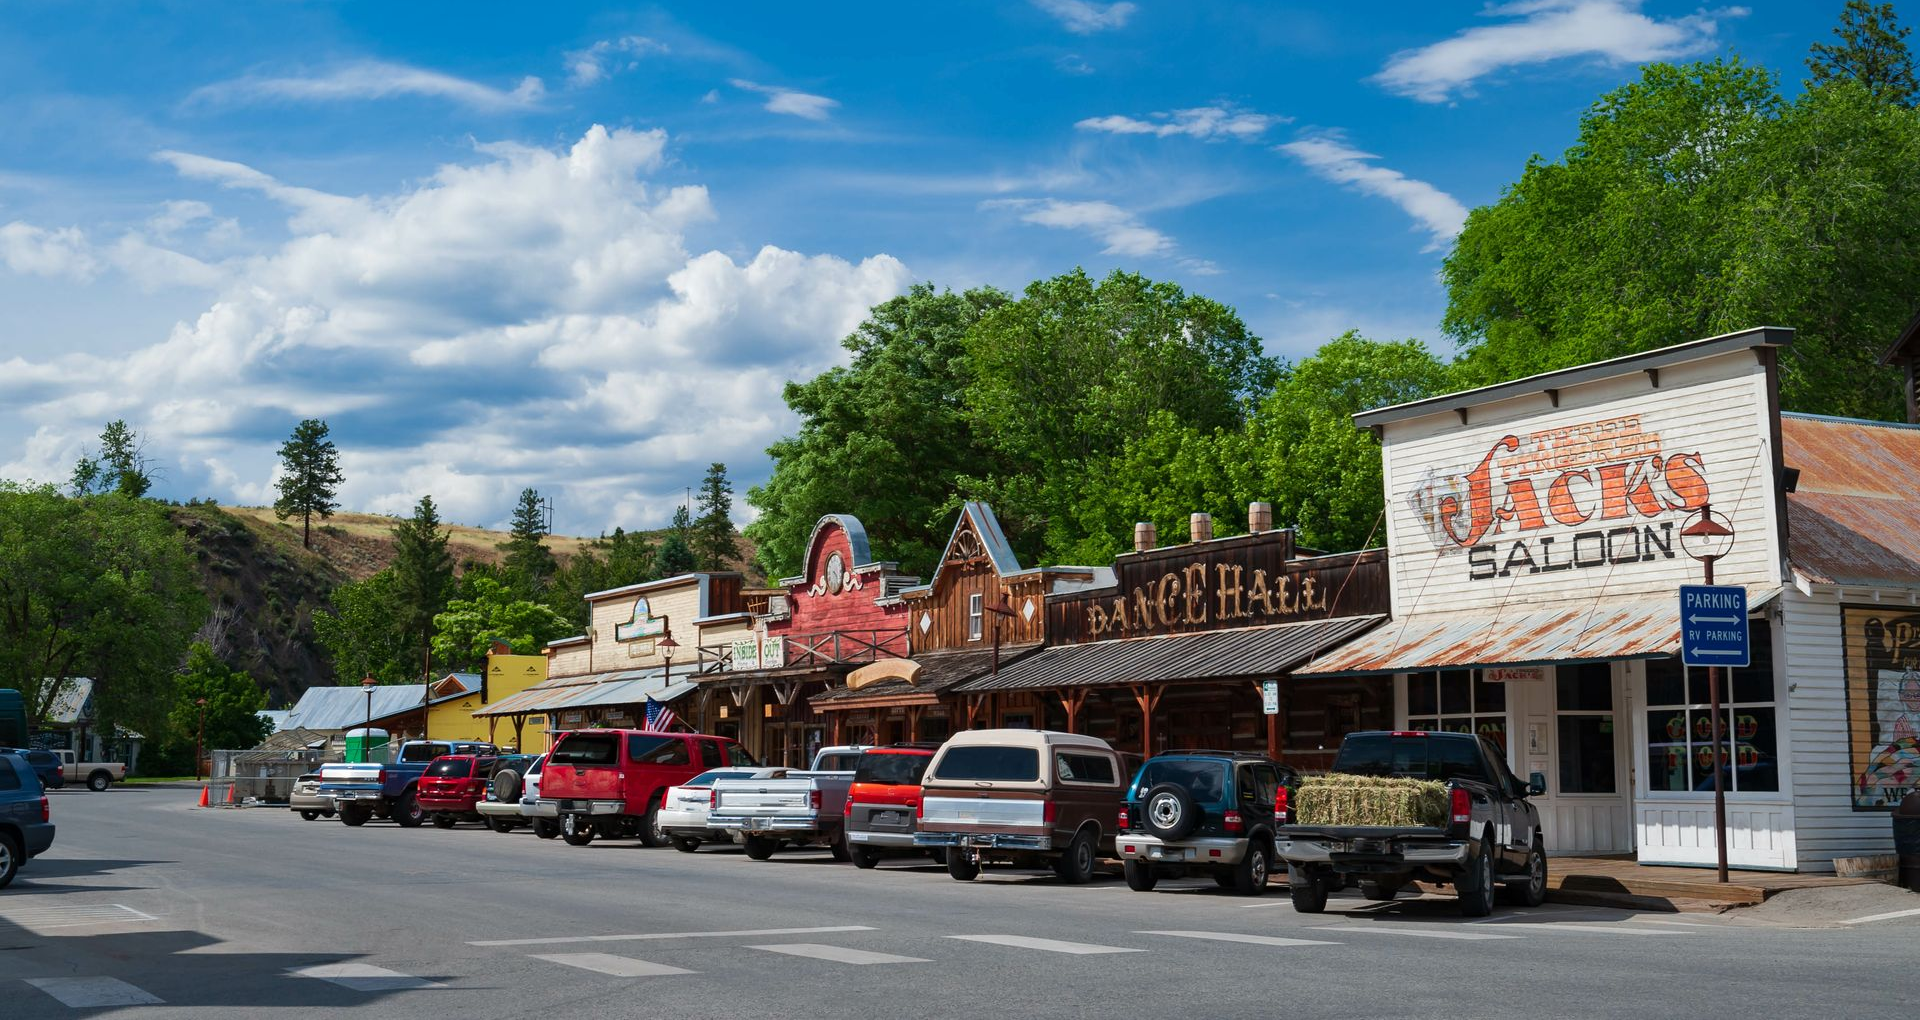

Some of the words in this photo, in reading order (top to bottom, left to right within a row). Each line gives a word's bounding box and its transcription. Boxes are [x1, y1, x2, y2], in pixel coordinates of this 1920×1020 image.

[1529, 413, 1643, 452] THREE
[1498, 434, 1663, 479] FINGERED
[1441, 434, 1711, 548] JACK'S
[1469, 521, 1676, 581] SALOON
[1086, 562, 1207, 635] DANCE
[1214, 562, 1327, 621] HALL
[1687, 593, 1740, 609] PARKING
[733, 645, 757, 661] INSIDE
[764, 643, 780, 658] OUT
[1689, 630, 1700, 641] RV
[1706, 630, 1742, 642] PARKING
